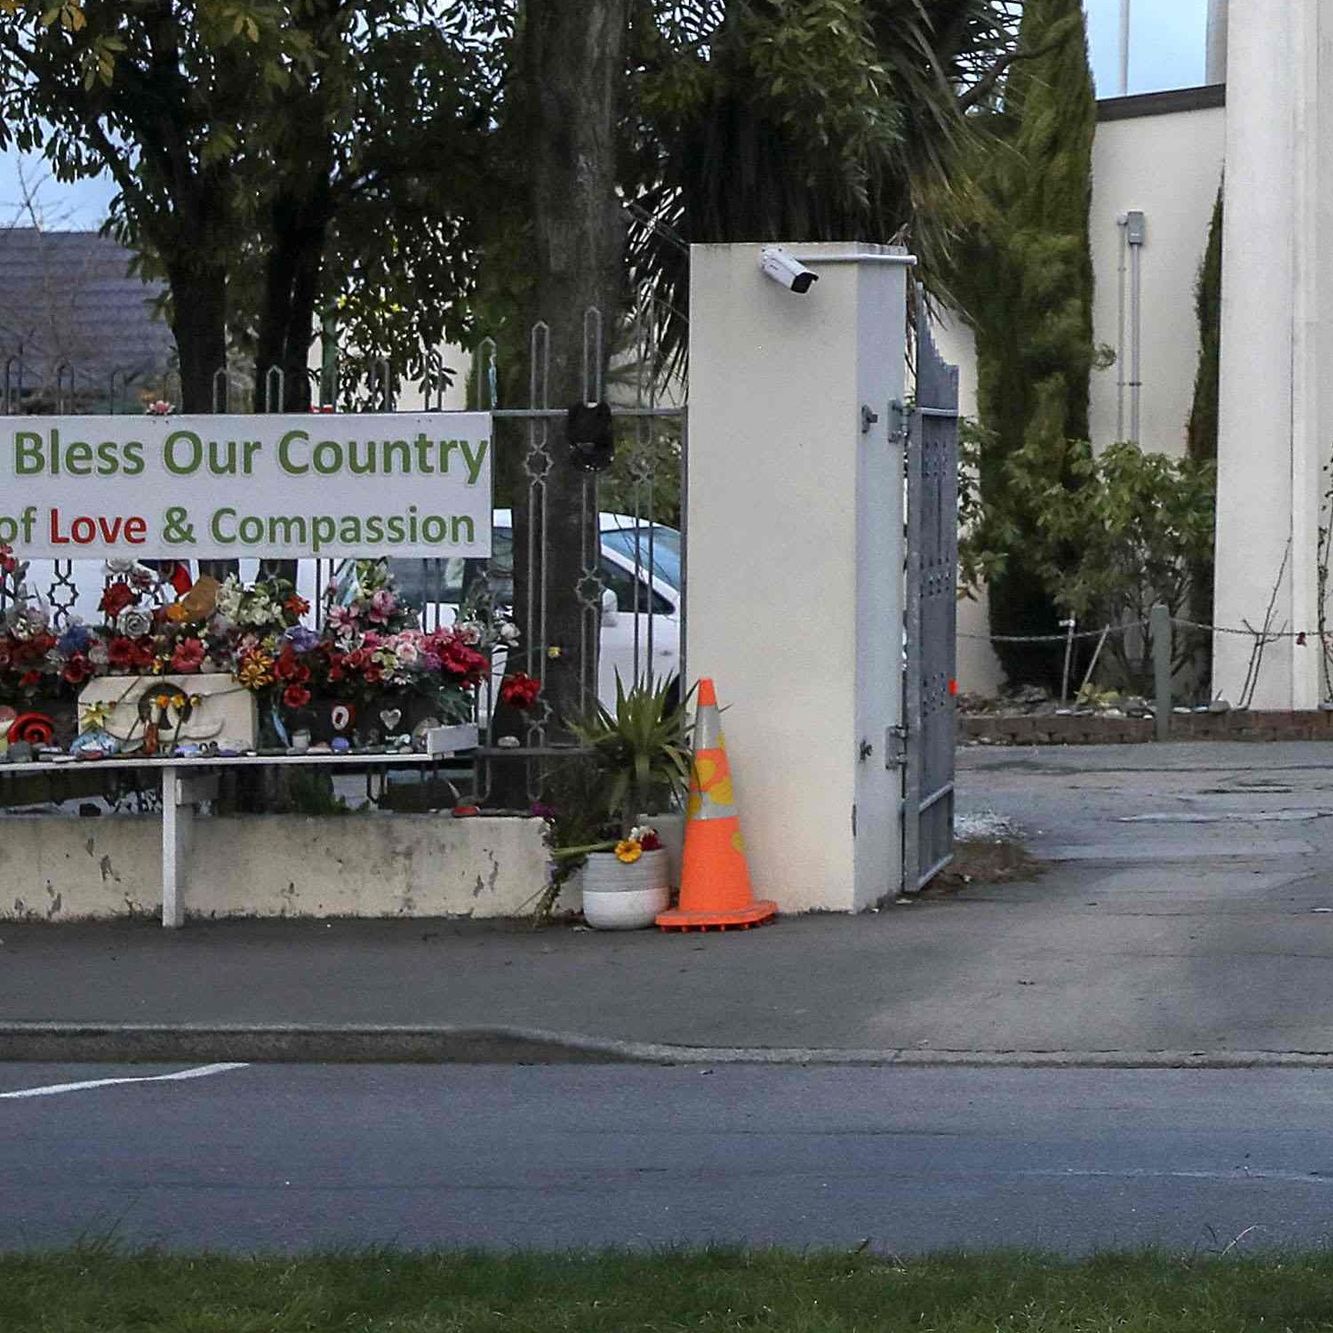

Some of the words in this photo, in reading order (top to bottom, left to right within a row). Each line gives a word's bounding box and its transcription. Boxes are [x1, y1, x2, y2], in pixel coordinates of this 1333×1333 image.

[14, 429, 145, 476] Bless
[163, 429, 262, 476] Our
[278, 429, 489, 485] Country
[0, 506, 38, 545] of
[50, 507, 148, 545] Love
[162, 506, 197, 545] &
[210, 505, 475, 553] Compassion
